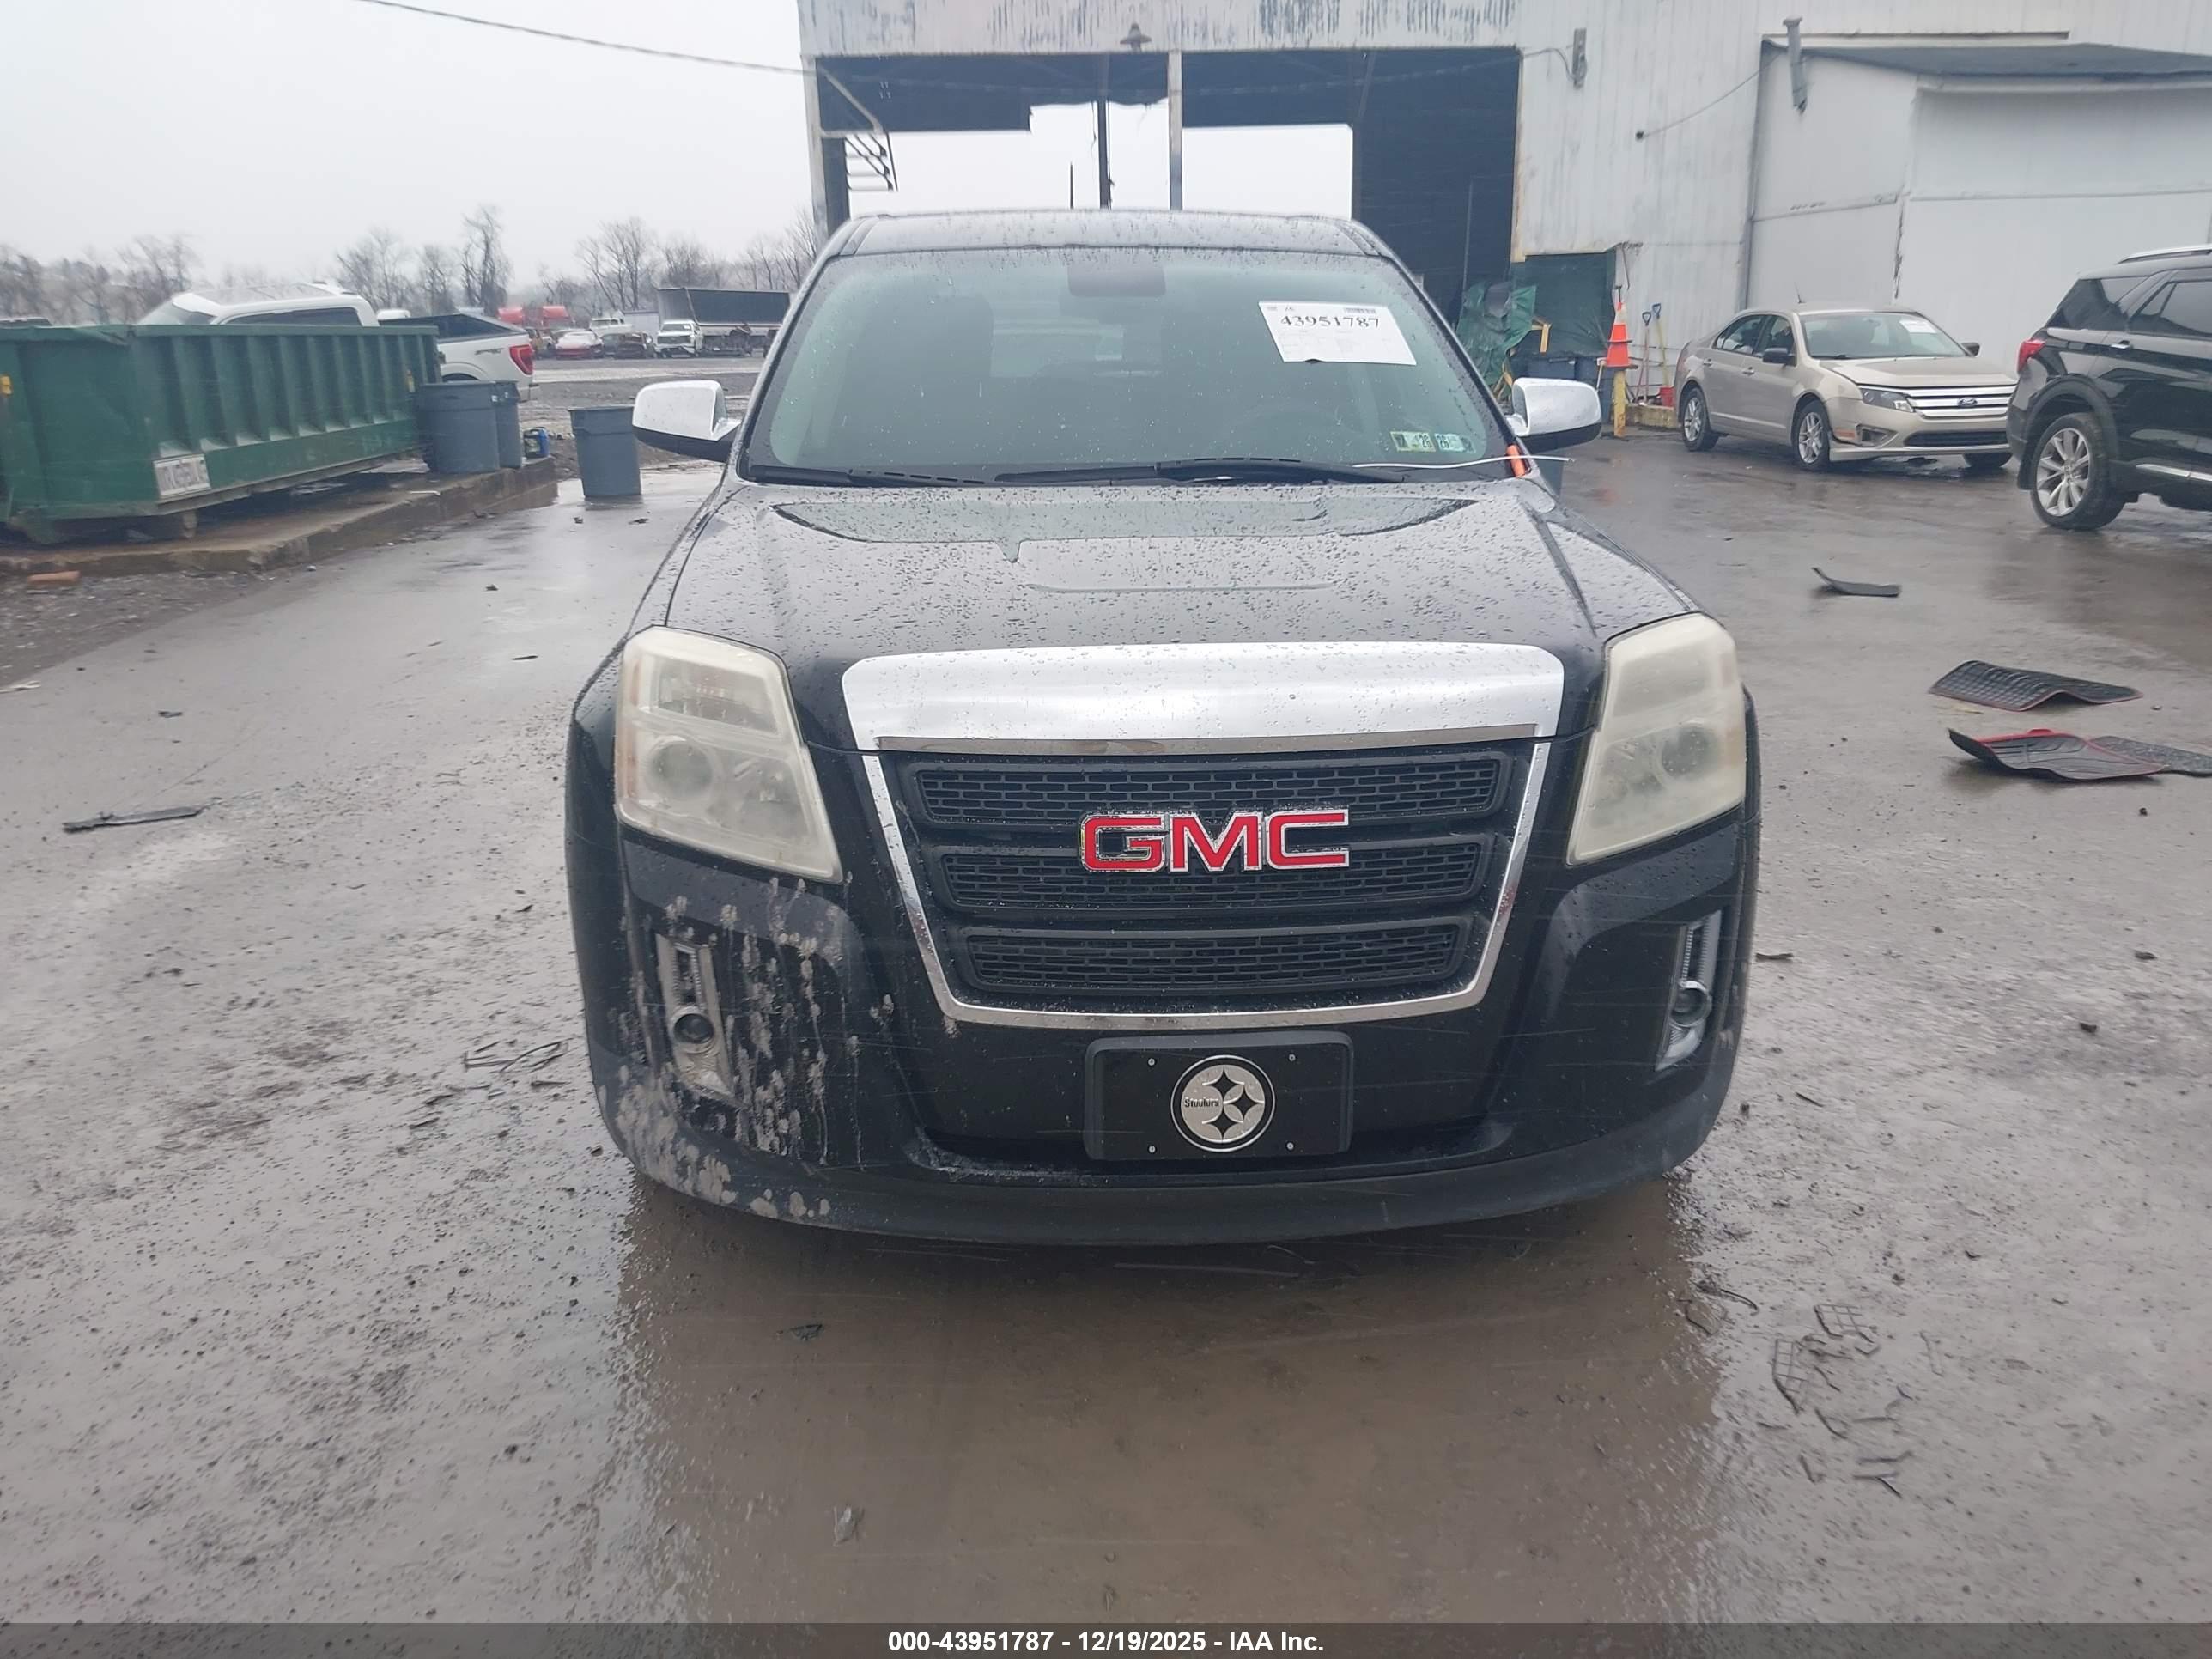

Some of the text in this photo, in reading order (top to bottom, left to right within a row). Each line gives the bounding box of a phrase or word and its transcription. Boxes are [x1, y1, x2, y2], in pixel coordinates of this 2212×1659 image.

[1280, 315, 1379, 328] 43951787
[1080, 810, 1349, 872] GMC
[1184, 1097, 1219, 1108] Steelers
